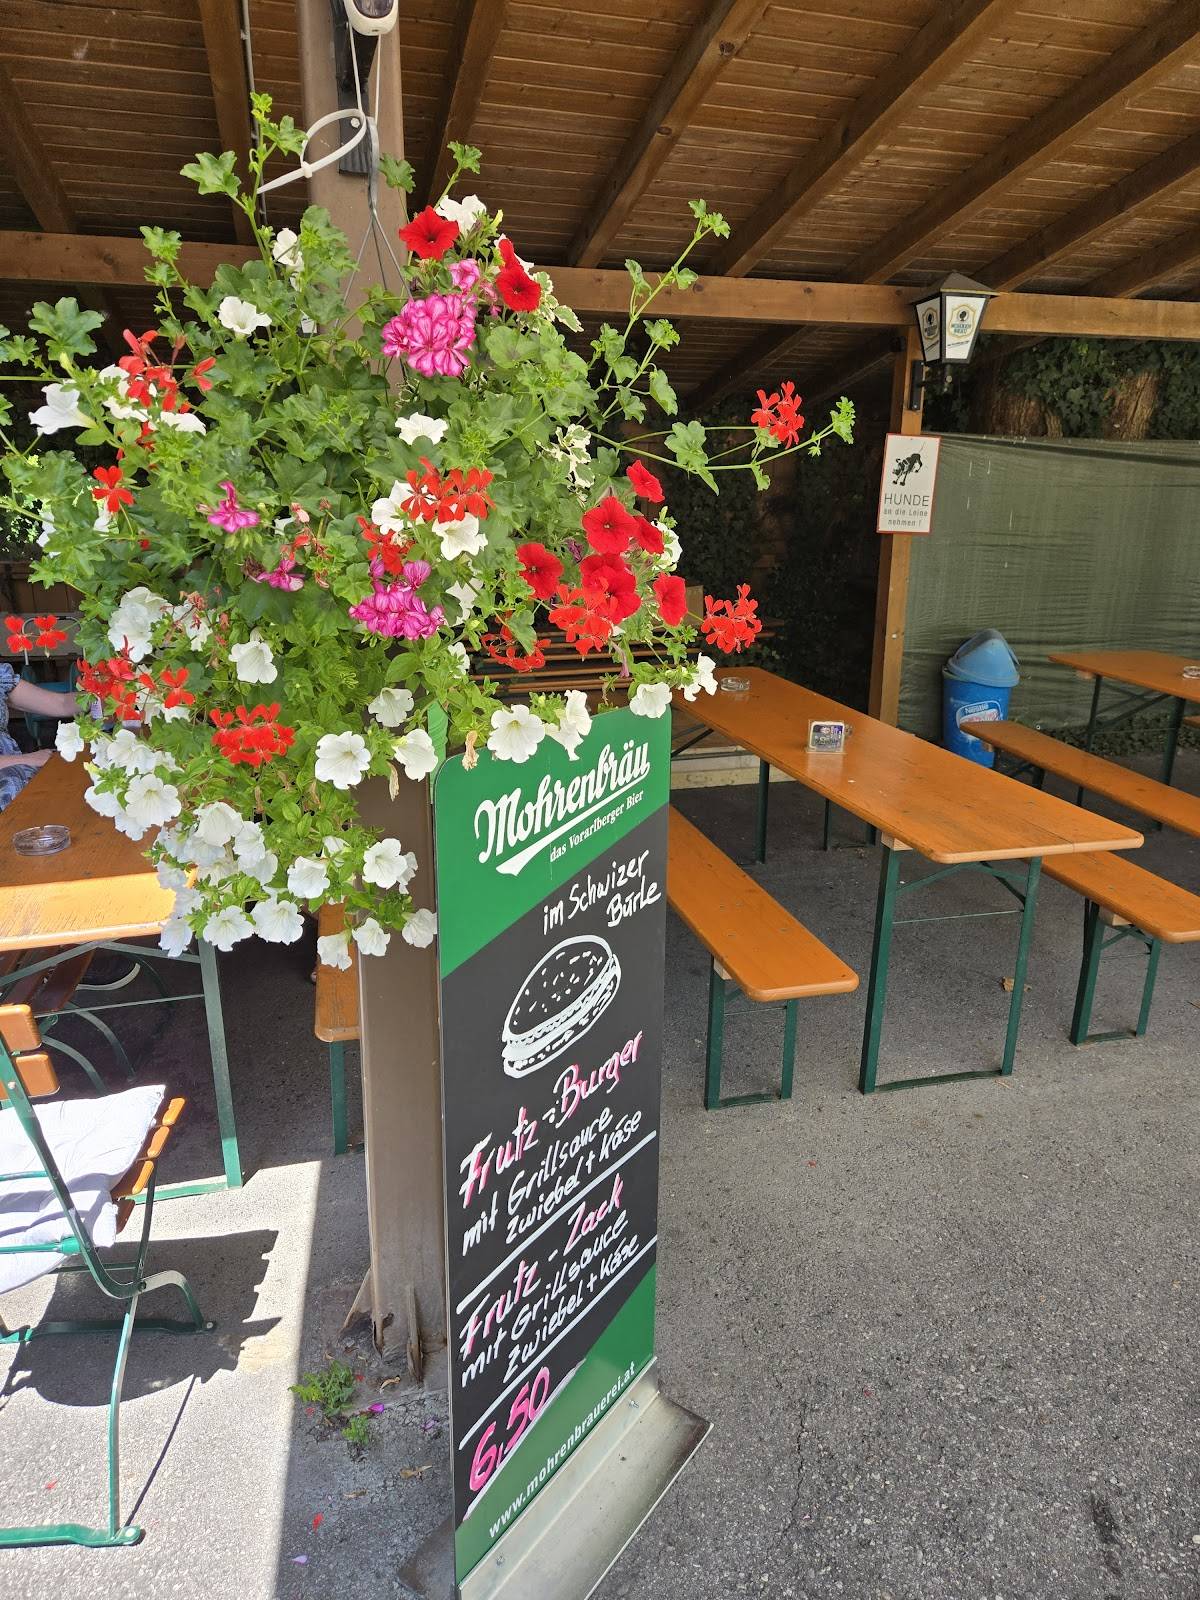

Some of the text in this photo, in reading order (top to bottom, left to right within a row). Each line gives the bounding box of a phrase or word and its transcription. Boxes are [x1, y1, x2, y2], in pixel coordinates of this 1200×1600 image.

[884, 493, 930, 507] HUNDE
[895, 508, 906, 516] die
[908, 509, 928, 517] Leine
[474, 740, 650, 864] Mohrenbräu
[550, 790, 644, 863] das Vorarlberger Bier
[543, 900, 563, 935] im
[462, 1107, 613, 1256] mit Grillsauce
[563, 1173, 624, 1256] Zack
[461, 1210, 629, 1388] mit Grillsauce
[489, 1360, 636, 1538] www.mohrenbrauerei.at
